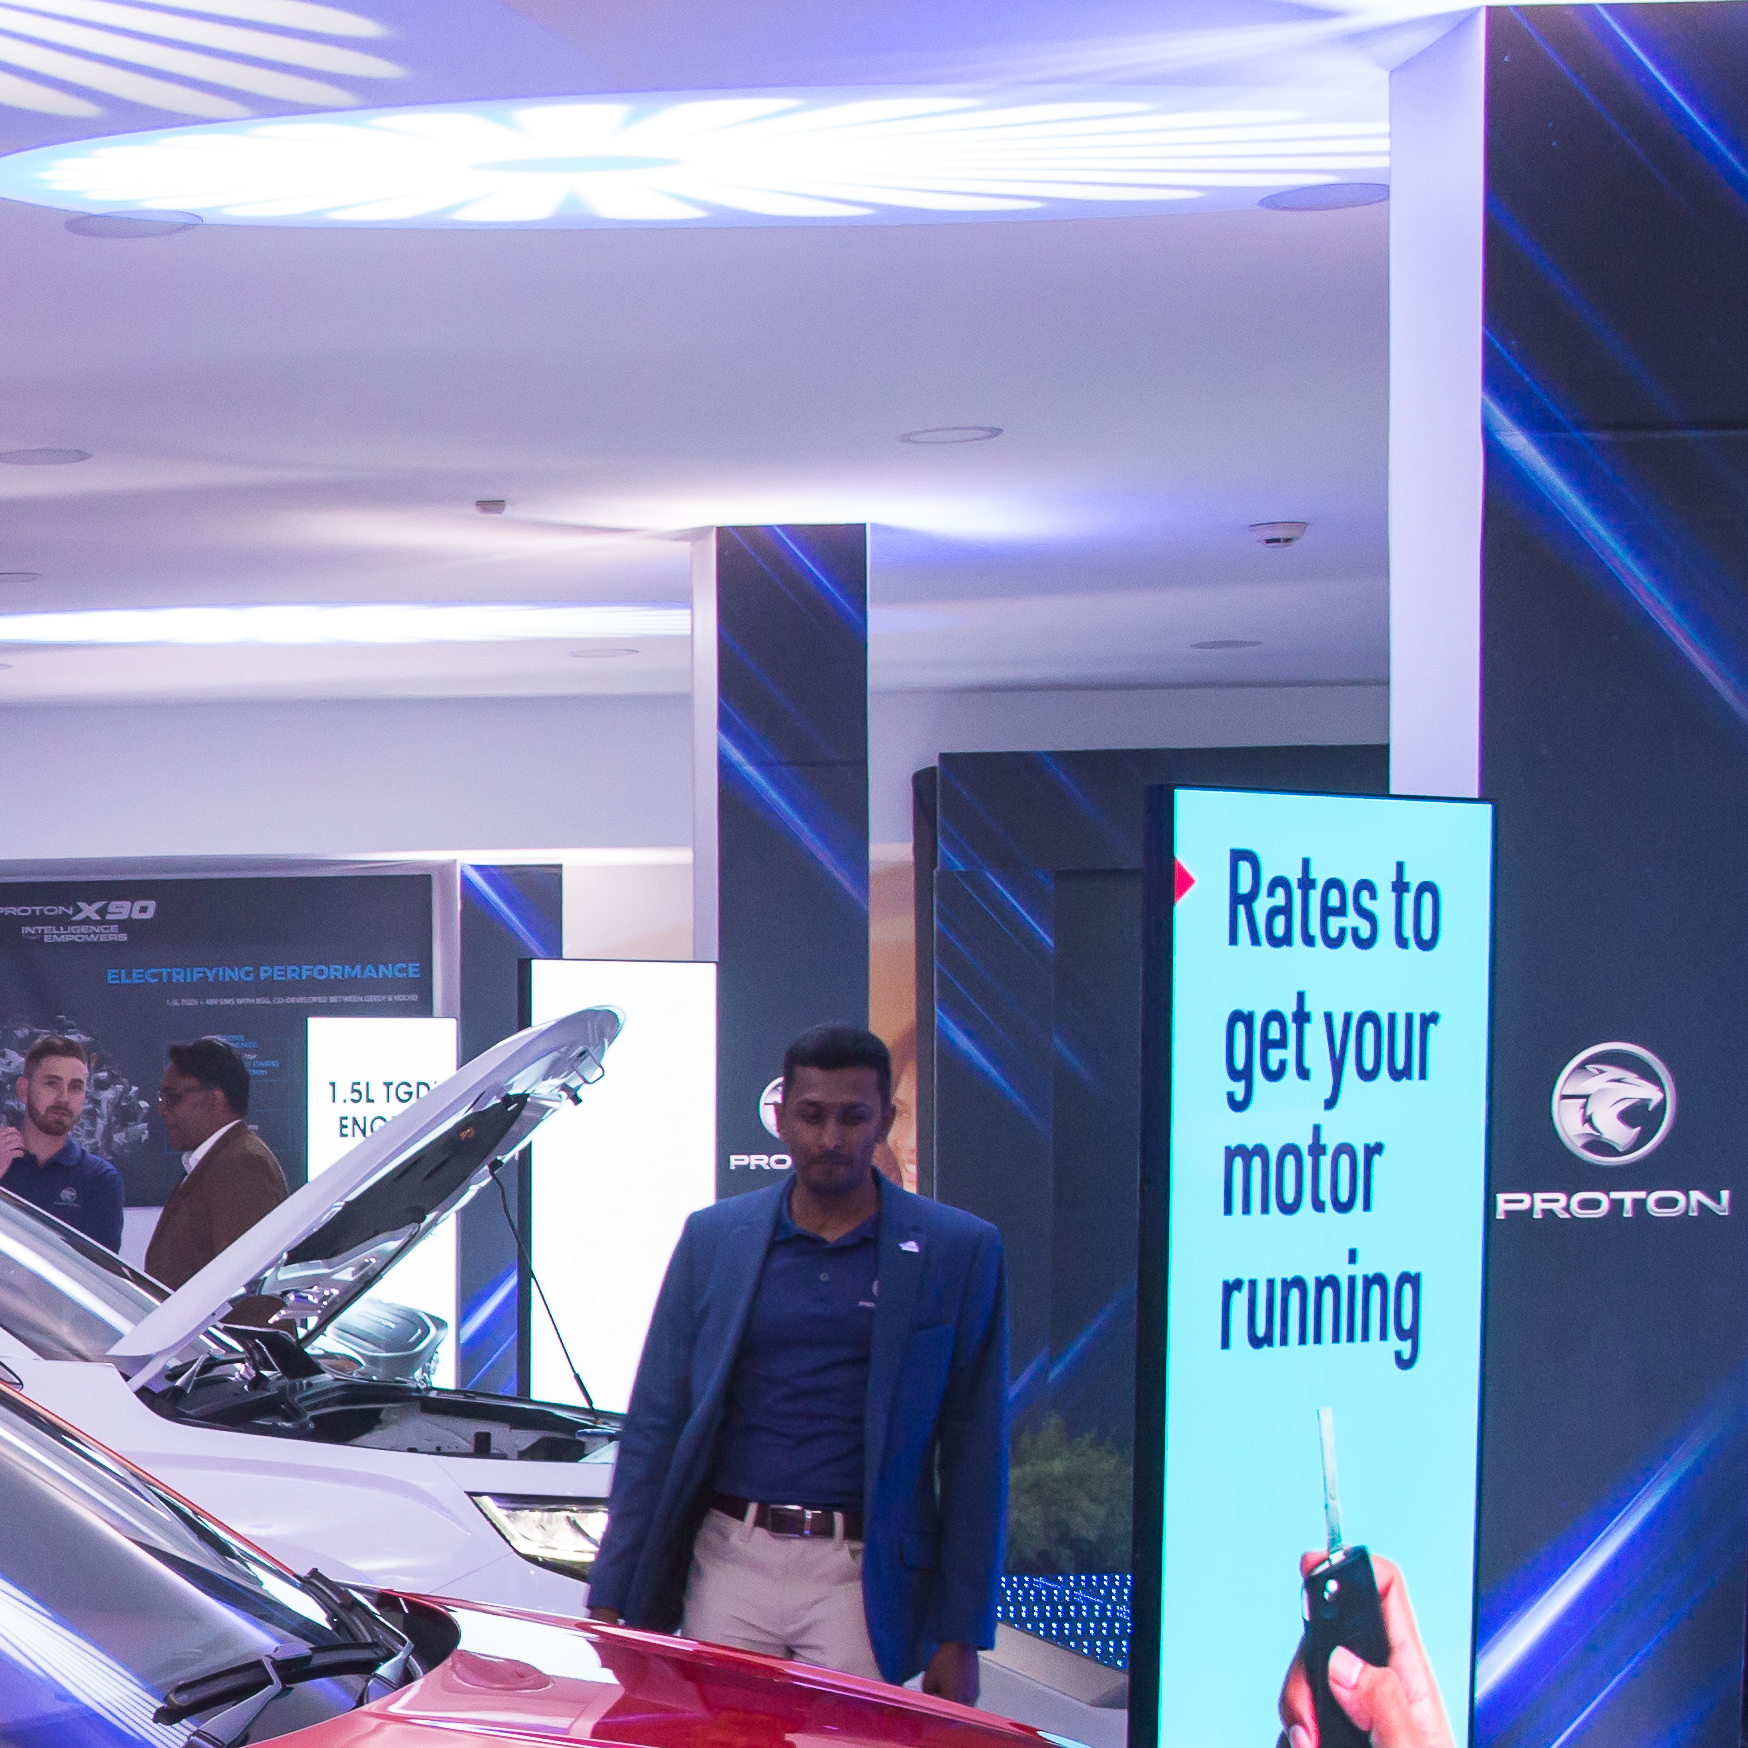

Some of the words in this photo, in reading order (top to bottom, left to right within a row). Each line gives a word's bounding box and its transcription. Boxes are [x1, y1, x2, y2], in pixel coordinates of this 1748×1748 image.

[70, 900, 157, 921] X90
[1228, 848, 1379, 951] Rates
[1391, 860, 1441, 952] to
[21, 924, 119, 934] INTELLIGENCE
[44, 933, 128, 943] EMPOWERS
[107, 965, 255, 985] ELECTRIFYING
[259, 962, 420, 983] PERFORMANCE
[1225, 990, 1311, 1113] get
[1323, 1010, 1440, 1112] your
[328, 1081, 375, 1104] 1.5L
[382, 1081, 438, 1104] TGD
[1224, 1123, 1384, 1217] motor
[1495, 1188, 1731, 1219] PROTON
[1220, 1248, 1422, 1371] running
